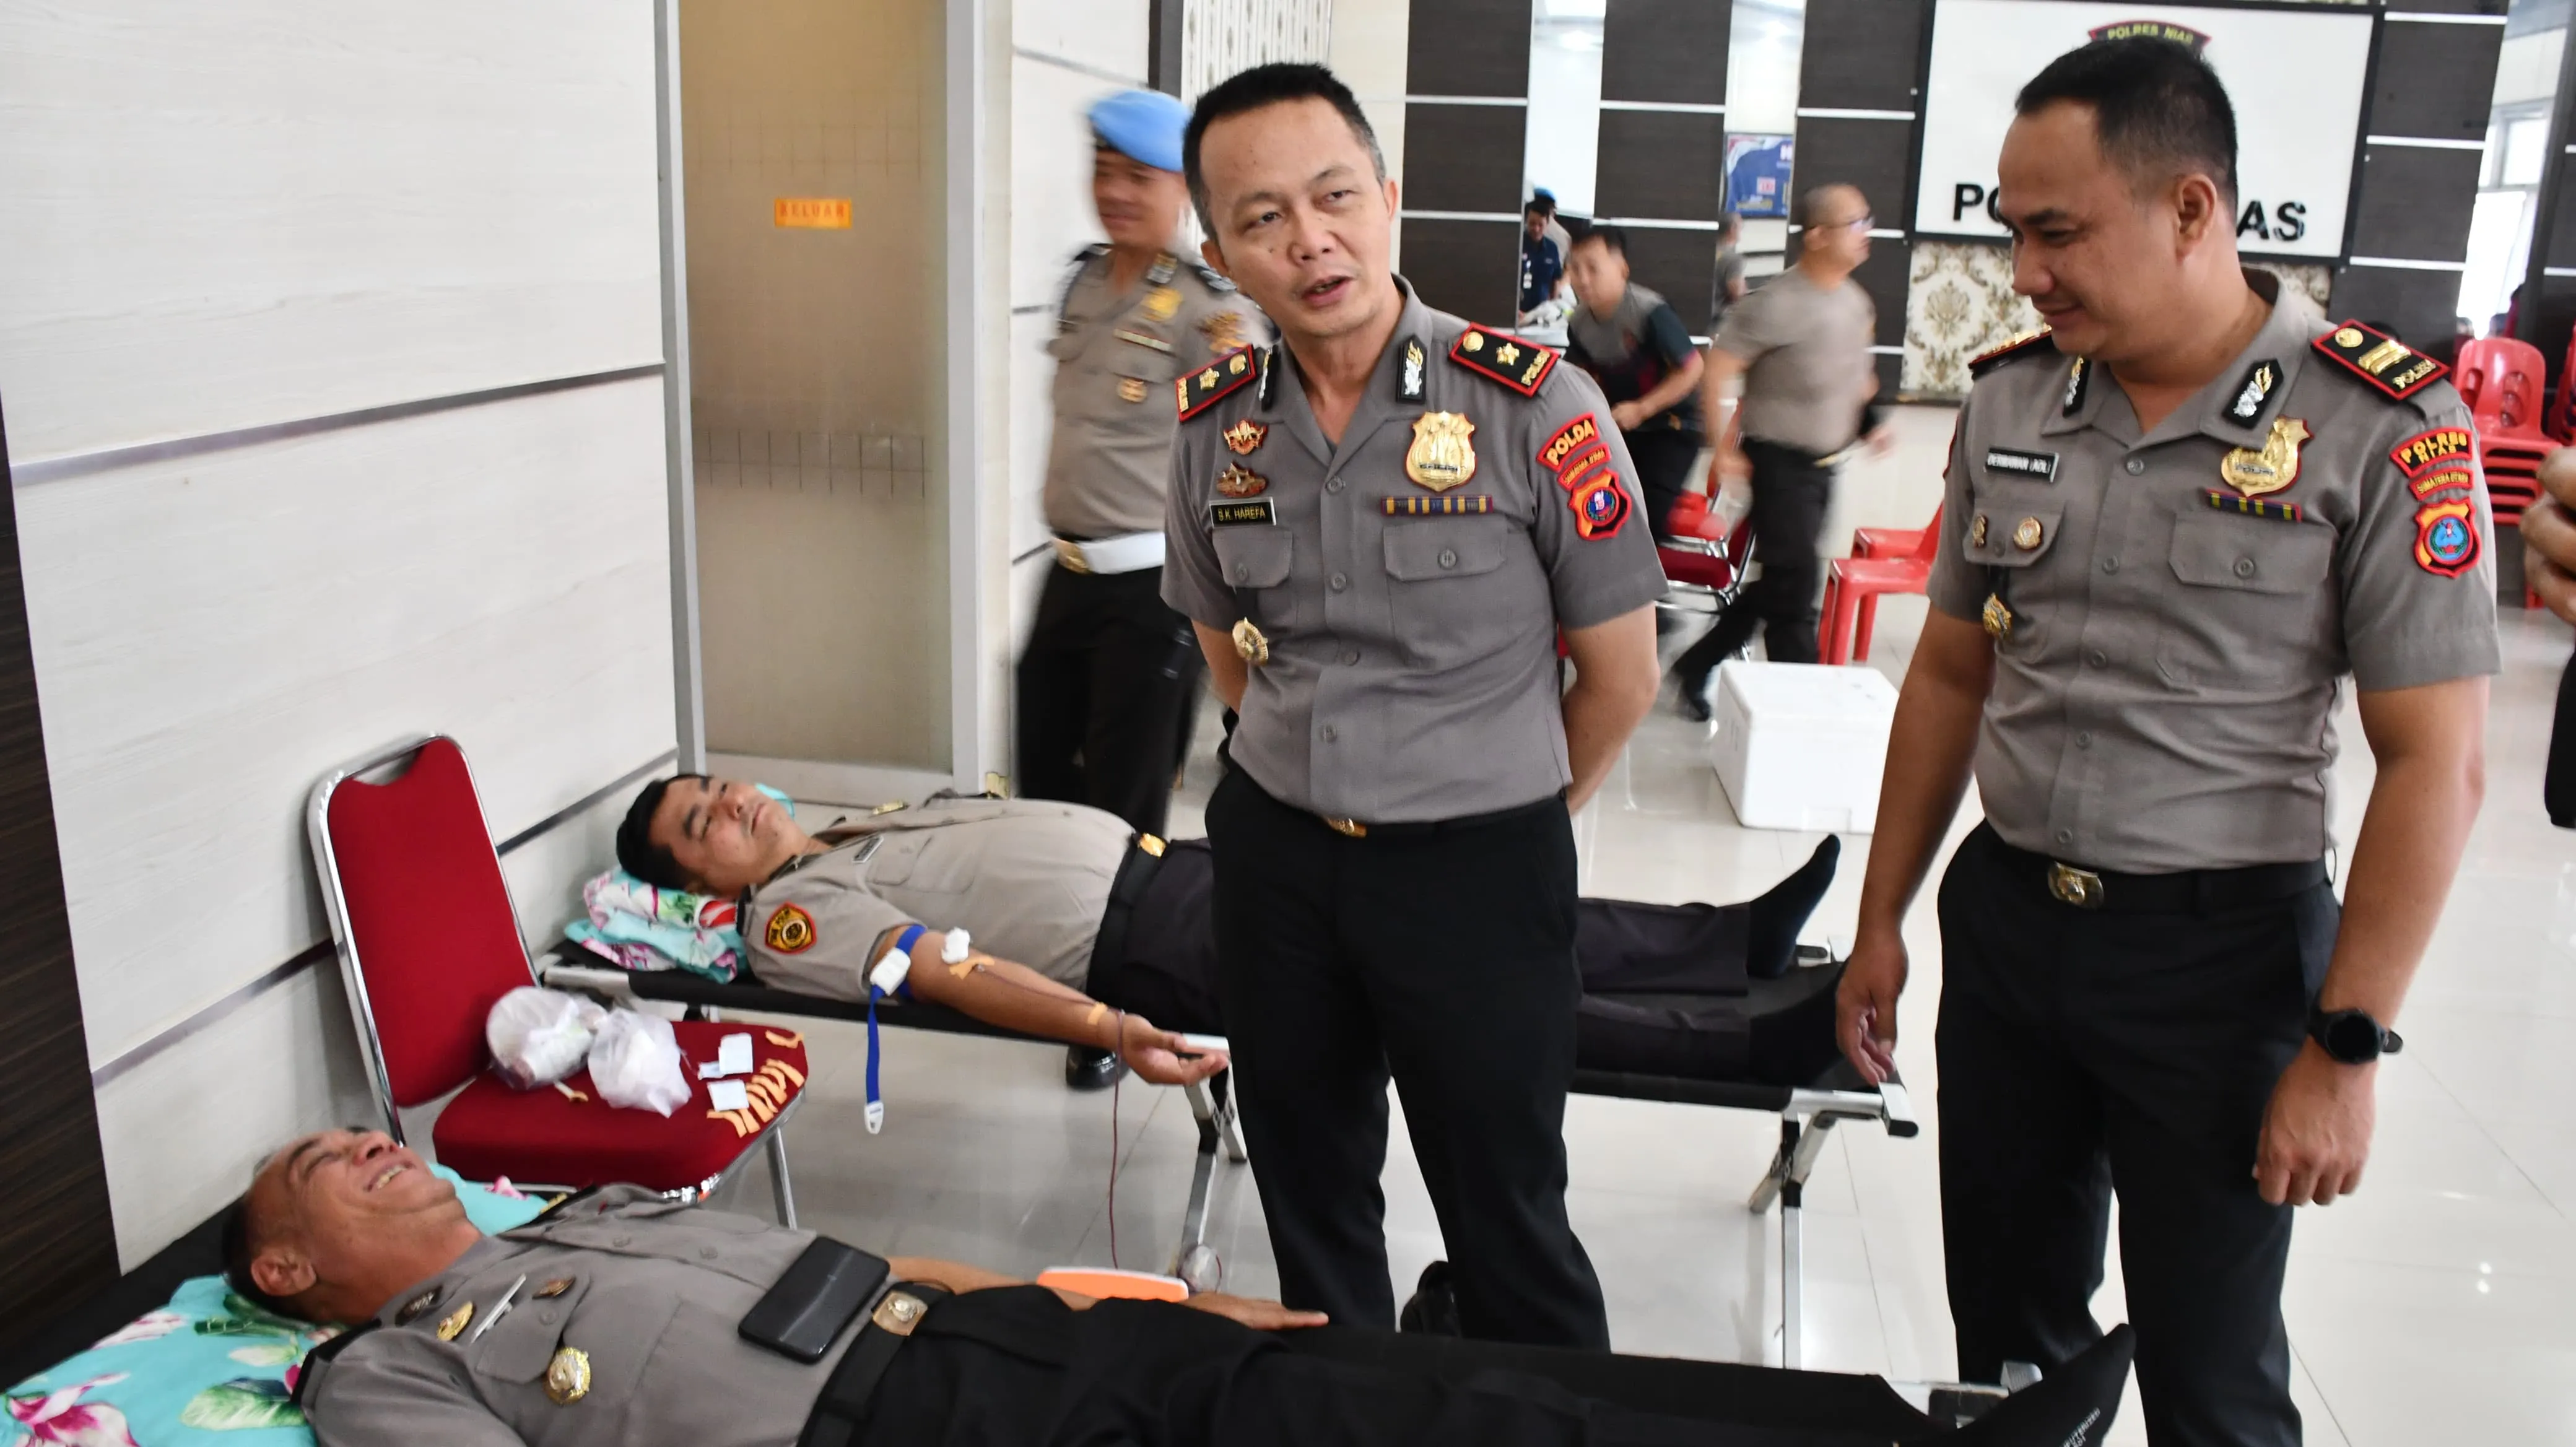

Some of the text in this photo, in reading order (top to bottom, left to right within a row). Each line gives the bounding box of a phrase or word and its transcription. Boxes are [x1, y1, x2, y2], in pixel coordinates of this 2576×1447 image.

[780, 202, 845, 218] KELUAR
[1546, 419, 1595, 466] POLDA
[2400, 431, 2468, 464] POLRES
[1234, 505, 1266, 520] HAREFA
